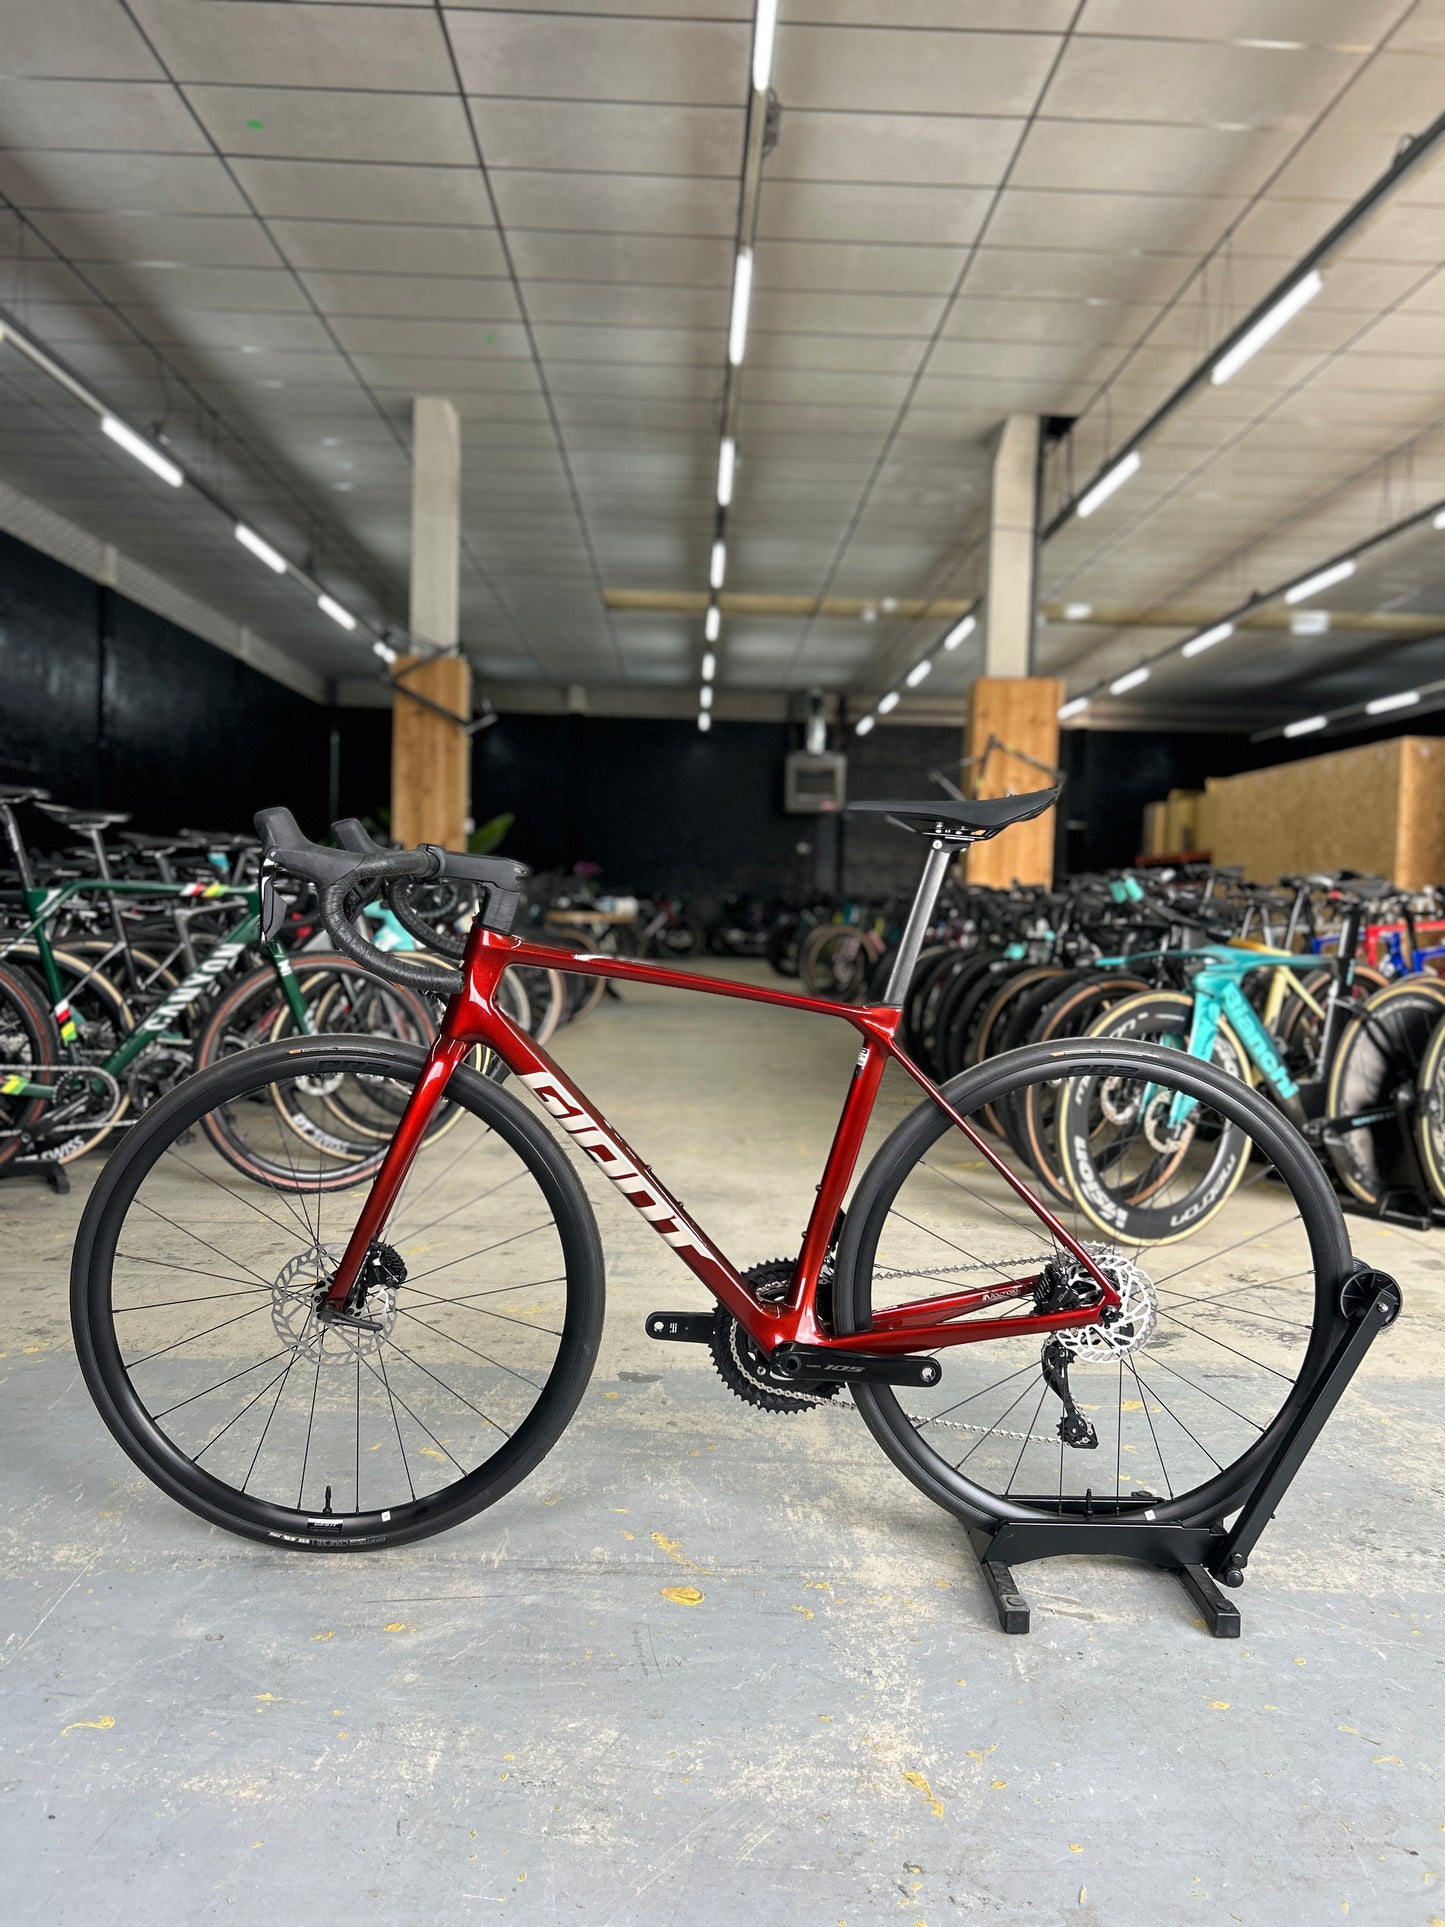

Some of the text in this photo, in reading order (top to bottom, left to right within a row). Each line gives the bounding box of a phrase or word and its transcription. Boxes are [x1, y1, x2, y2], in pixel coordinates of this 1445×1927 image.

[144, 943, 246, 1031] CANYON
[1222, 981, 1299, 1099] Bianchi
[517, 1071, 717, 1261] GIANT
[824, 1364, 866, 1373] 105
